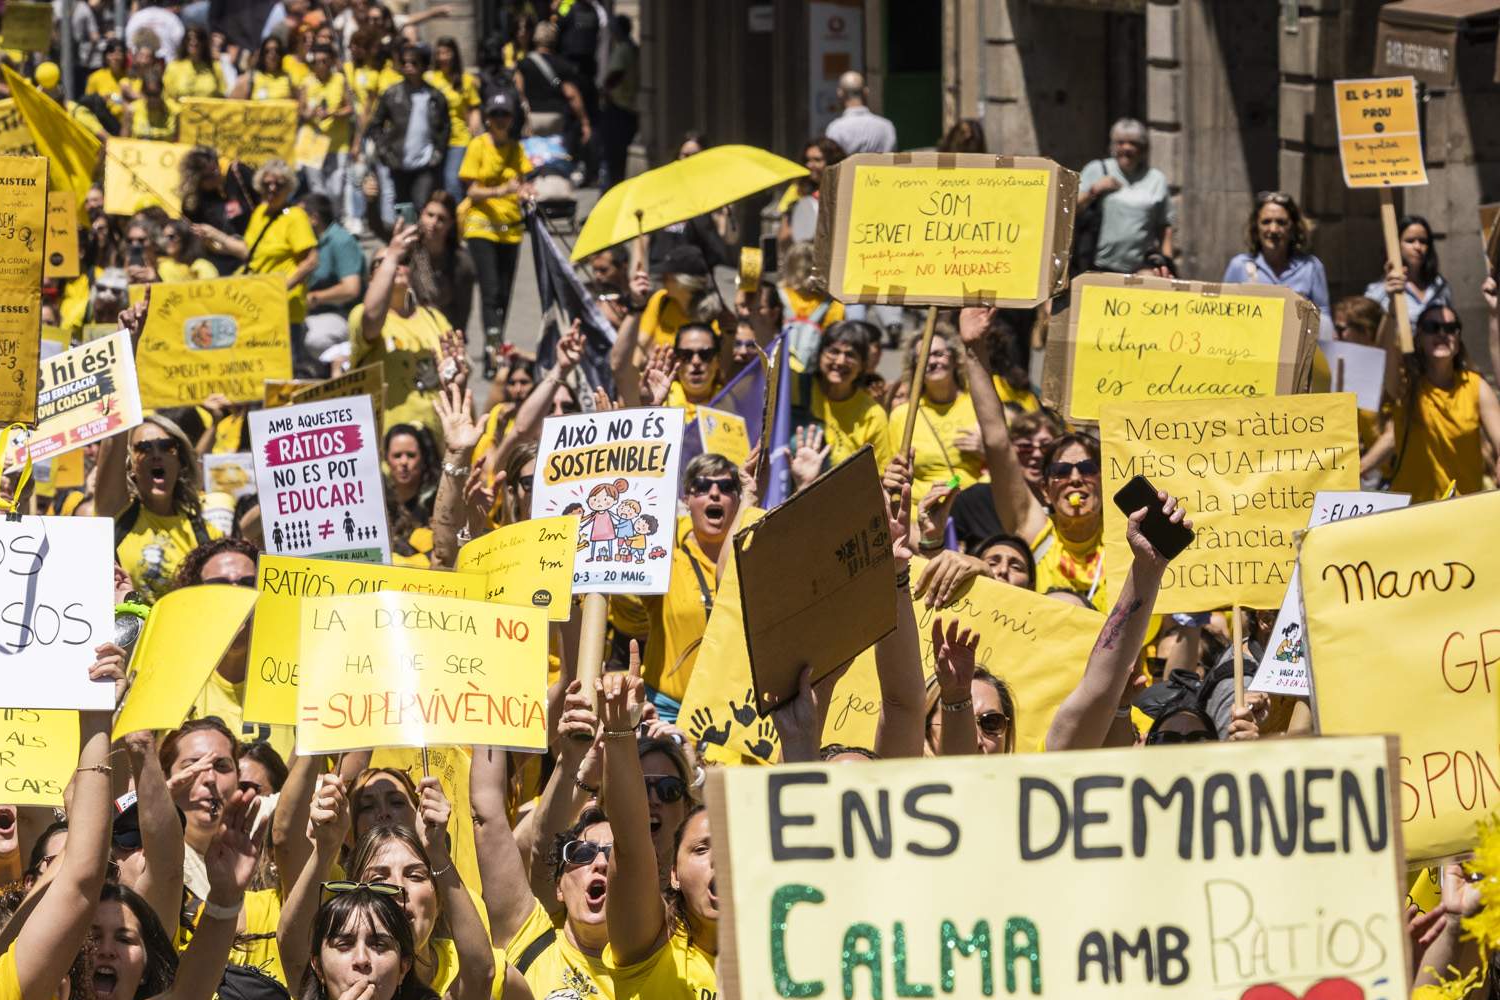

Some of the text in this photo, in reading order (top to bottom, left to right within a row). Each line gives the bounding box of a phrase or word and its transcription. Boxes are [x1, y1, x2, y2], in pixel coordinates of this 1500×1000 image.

[1362, 107, 1391, 118] PROU
[864, 174, 881, 187] No
[918, 191, 972, 217] SOM
[853, 220, 1021, 245] SERVEI EDUCATIU
[915, 263, 1012, 277] NO VALORADES
[1103, 299, 1263, 319] NO SOM GUARDERIA
[1093, 328, 1256, 366] l'etapa anys
[50, 339, 117, 387] hi és!
[51, 374, 97, 400] EDUCACIÓ
[1095, 364, 1268, 398] és educació
[268, 408, 354, 435] AMB AQUESTES
[554, 411, 666, 450] AIXÒ NO ÉS
[1124, 411, 1325, 446] Menys ràtios
[278, 430, 347, 462] RÀTIOS
[273, 458, 358, 489] NO ES POT
[549, 443, 673, 482] SOSTENIBLE!
[1109, 446, 1346, 481] MÉS QUALITAT.
[276, 480, 366, 516] EDUCAR!
[1195, 486, 1316, 517] la petita
[573, 570, 646, 583] 0-3 20 MAIG
[1322, 560, 1476, 605] Mans
[312, 602, 530, 643] LA DOCÈNCIA NO
[345, 652, 487, 677] HA DE SER
[320, 681, 548, 730] SUPERVIVÈNCIA
[5, 730, 47, 749] ALS
[4, 777, 64, 795] CAPS
[767, 766, 1390, 865] ENS DEMANEN
[1076, 923, 1191, 988] AMB
